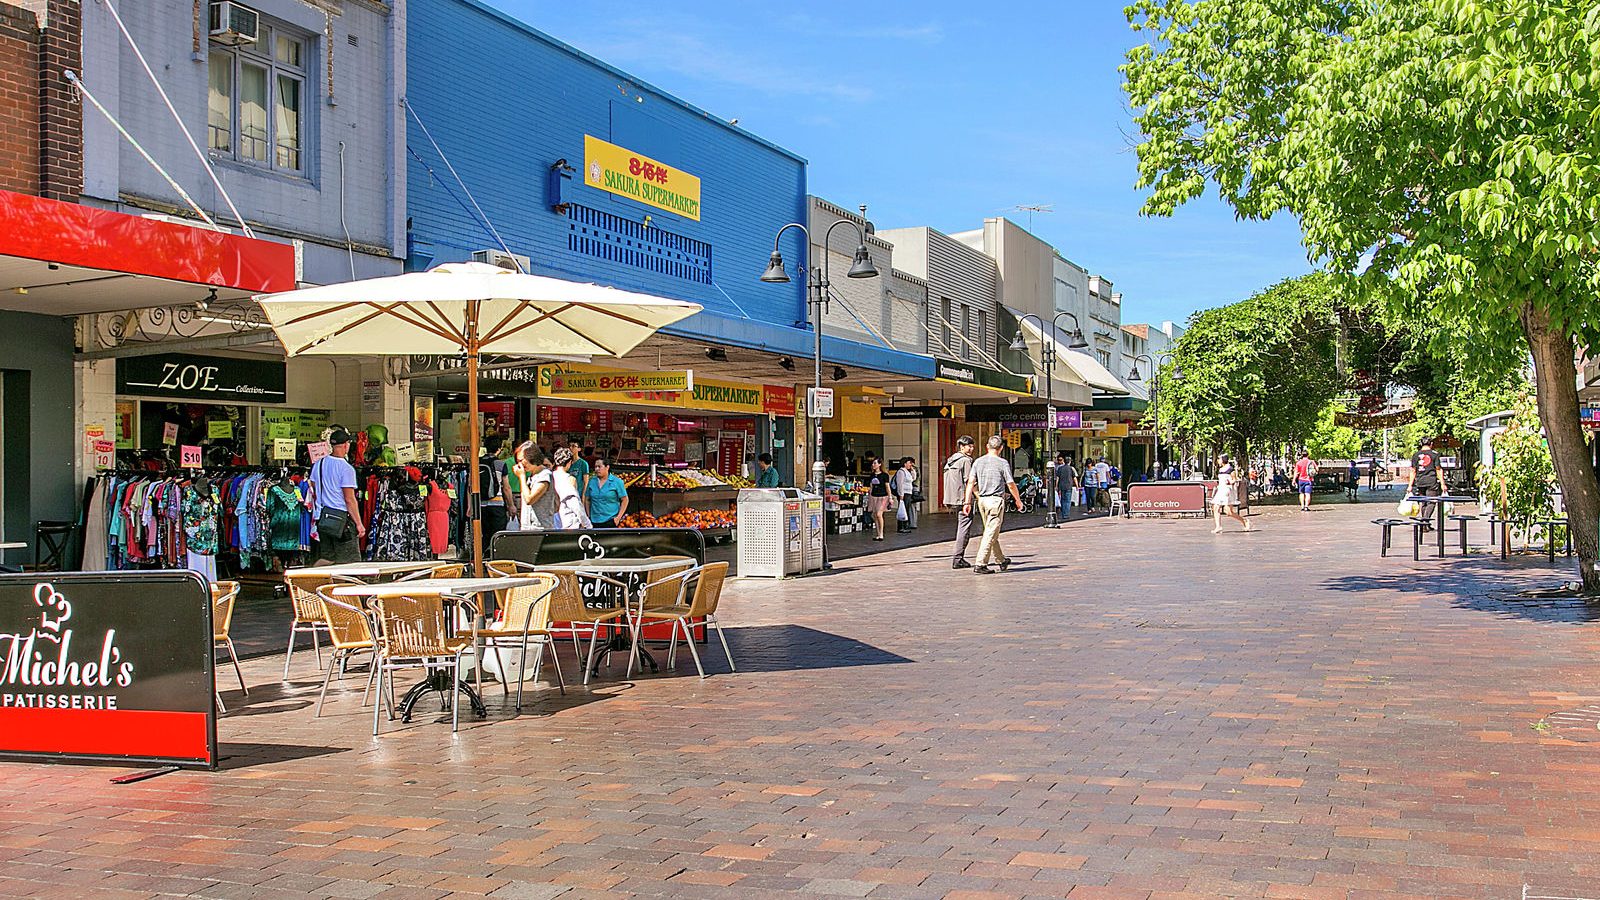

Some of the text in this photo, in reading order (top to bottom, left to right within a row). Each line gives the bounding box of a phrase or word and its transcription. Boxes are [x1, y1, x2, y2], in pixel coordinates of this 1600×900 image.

[604, 169, 699, 217] SAKURA SUPERMARKET
[158, 362, 264, 394] ZOE Collections
[567, 379, 597, 388] SAKURA
[641, 376, 686, 386] SUPERMARKET
[692, 383, 760, 406] SUPERMARKET
[1019, 412, 1047, 420] centro
[183, 452, 201, 463] $10
[0, 628, 134, 687] Michel's
[3, 694, 117, 710] PATISSERIE
